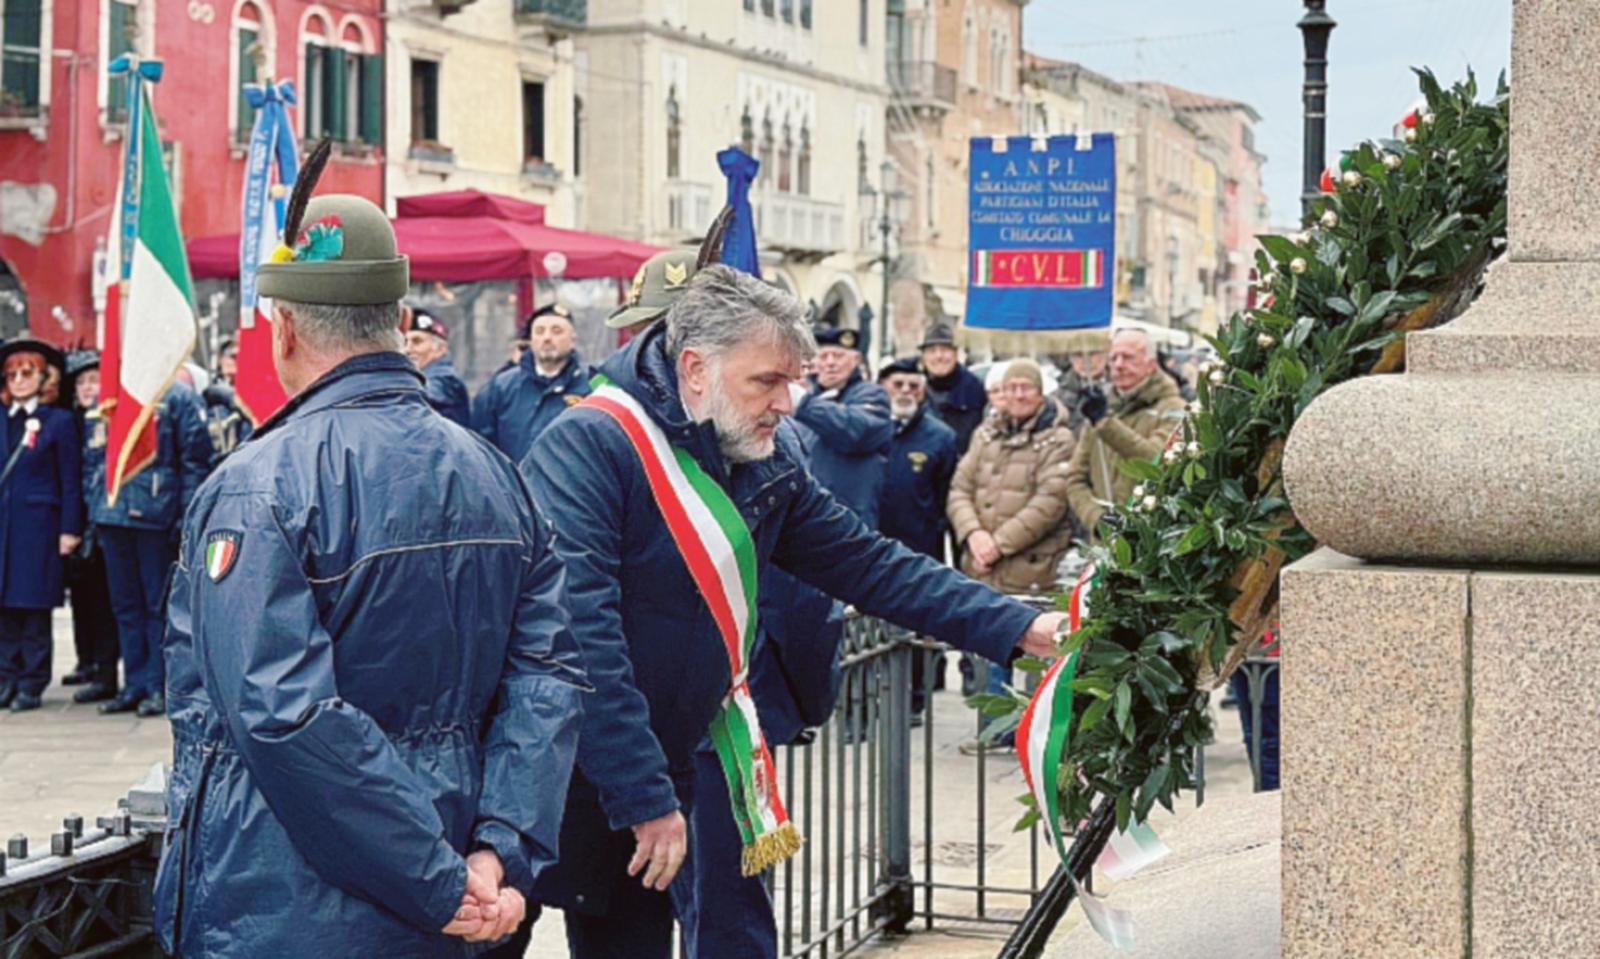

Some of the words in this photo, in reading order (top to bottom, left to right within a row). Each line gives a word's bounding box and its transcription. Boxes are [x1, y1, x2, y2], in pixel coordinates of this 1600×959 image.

[1049, 179, 1109, 193] NAZIONALE
[980, 195, 1043, 208] PARTIGIANI
[1029, 210, 1092, 224] COMUNALE
[1000, 227, 1074, 242] CHIOGGIA
